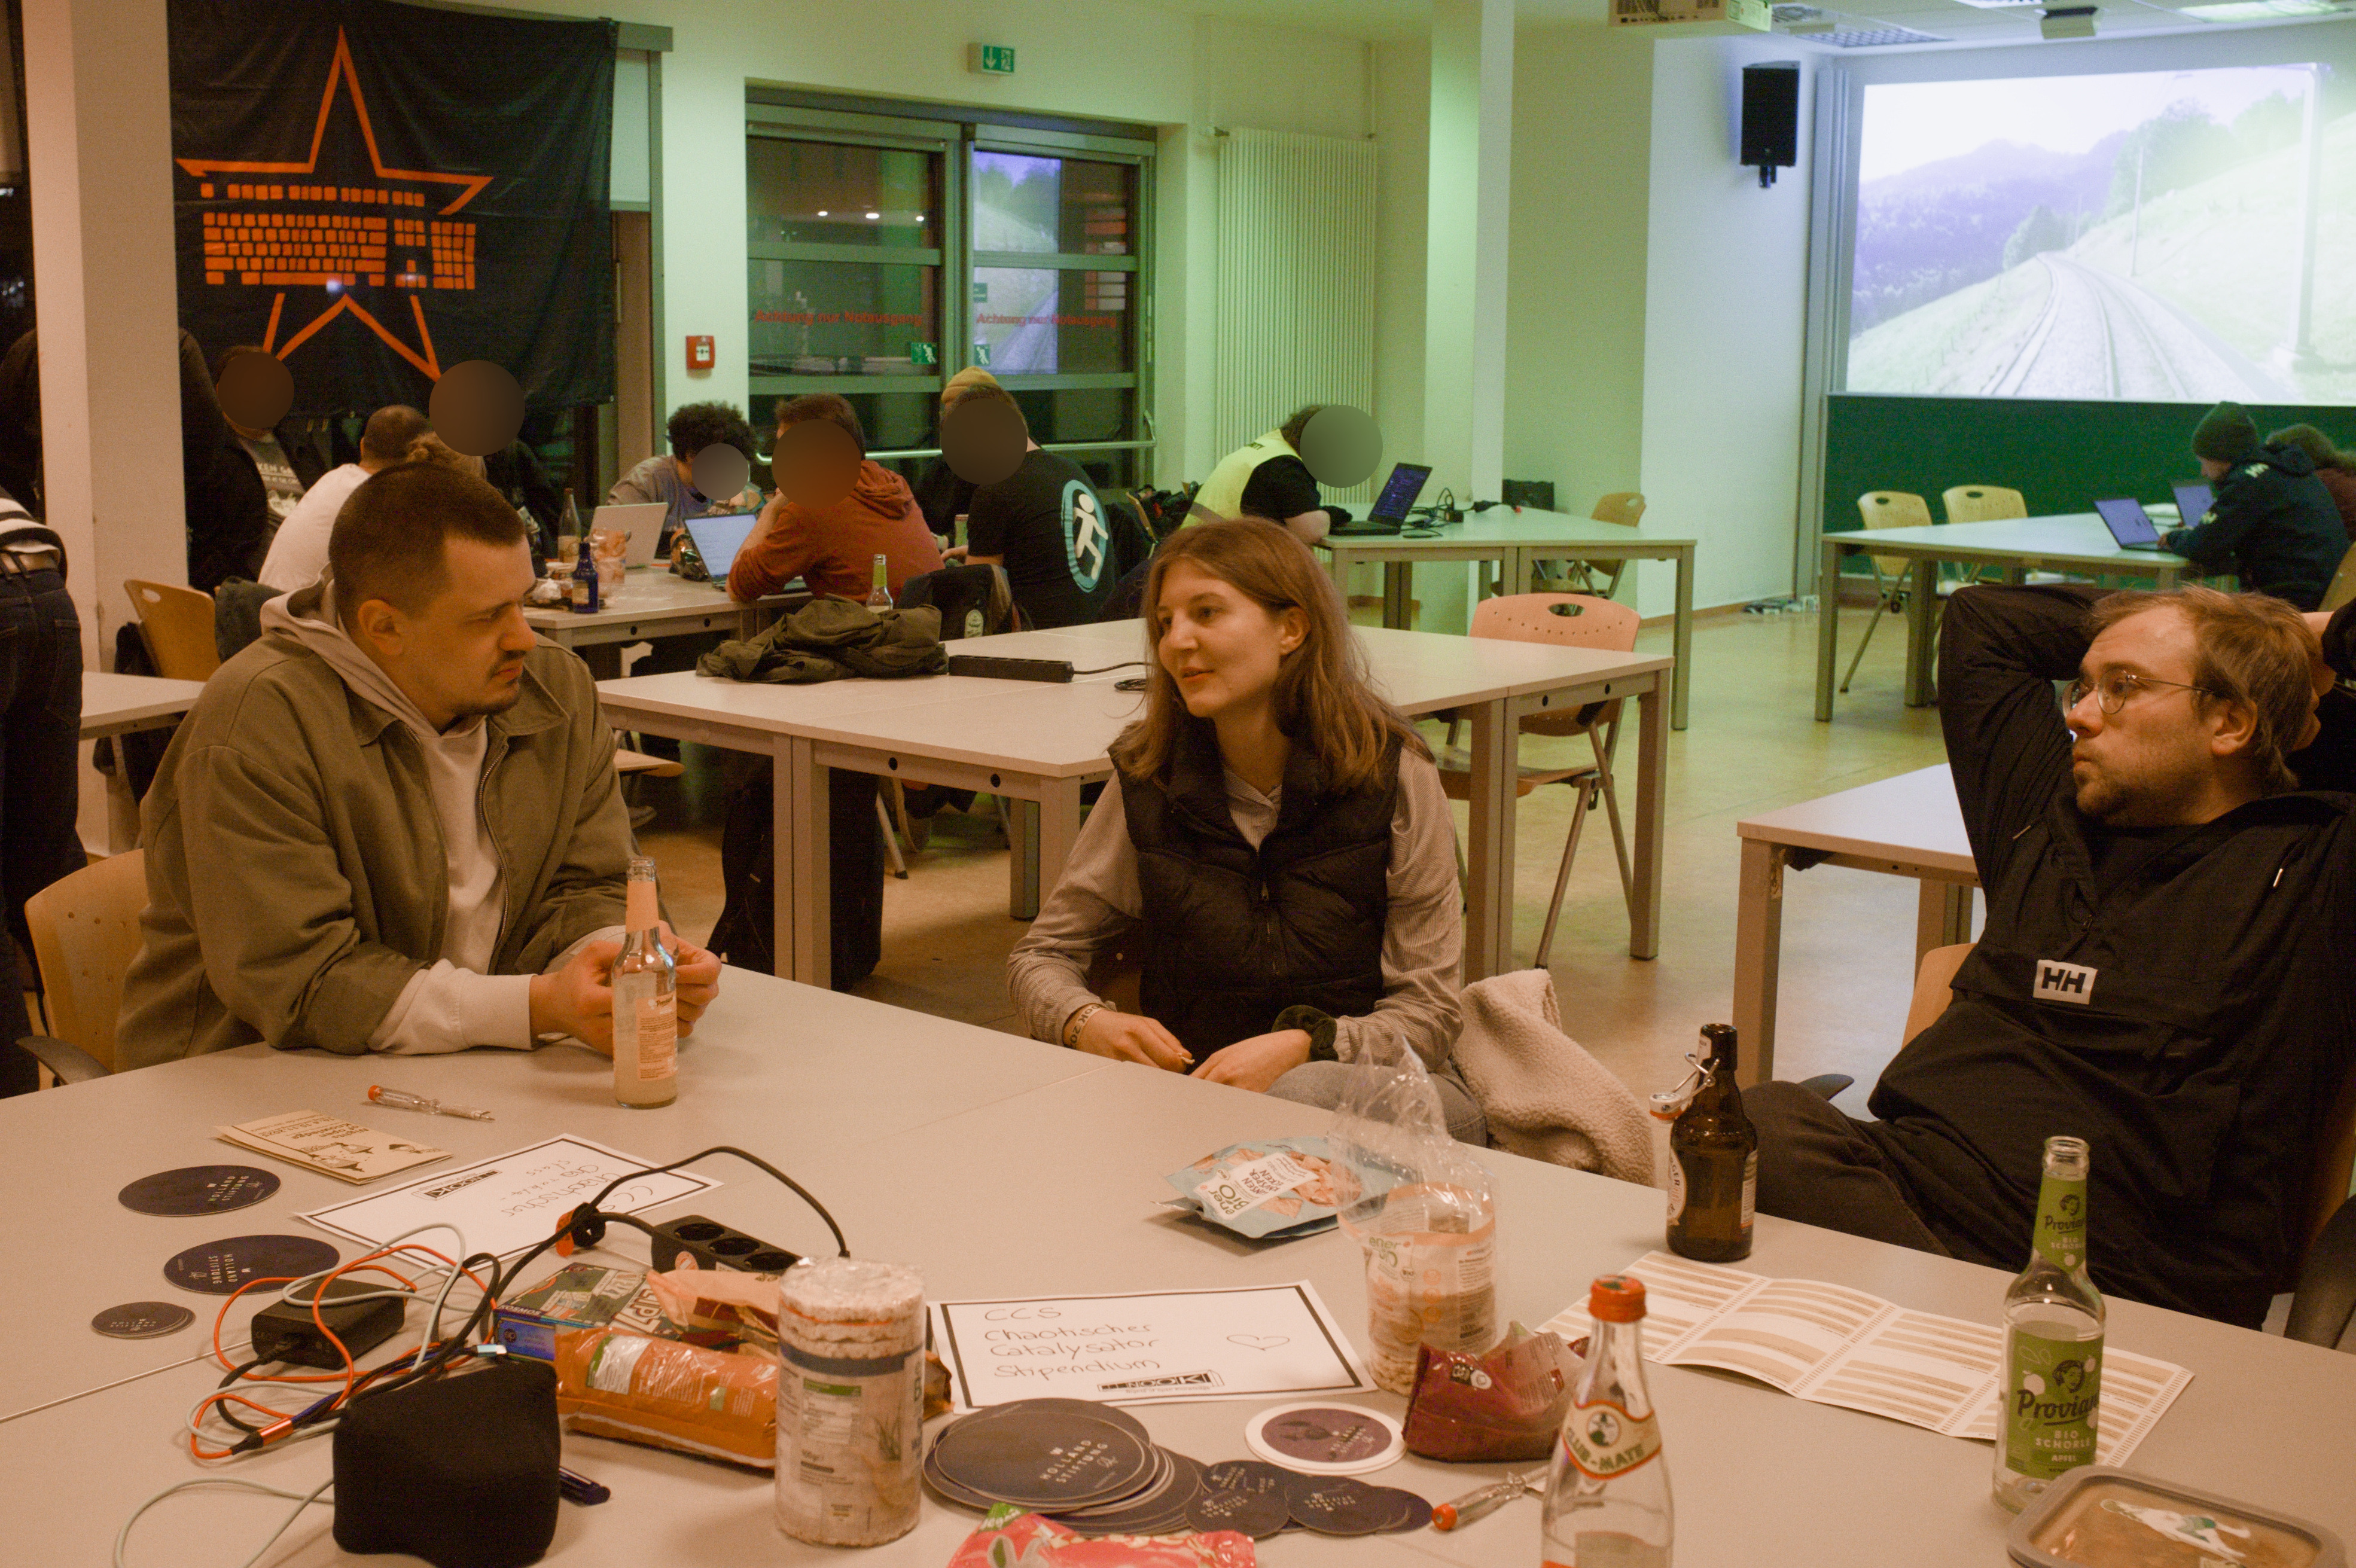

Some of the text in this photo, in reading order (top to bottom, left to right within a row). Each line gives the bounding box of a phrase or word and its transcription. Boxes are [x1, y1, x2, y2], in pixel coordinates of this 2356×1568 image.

[755, 310, 922, 328] Achtung nur Notausgang
[977, 313, 1117, 328] Achtung nur Notausgang
[2041, 967, 2087, 994] HH
[291, 1122, 352, 1139] Knowledge
[331, 1127, 370, 1139] Nights
[1208, 1190, 1236, 1215] ener
[1369, 1236, 1401, 1250] ener
[498, 1304, 543, 1317] KOSMOS
[985, 1307, 1062, 1321] CCS
[985, 1324, 1151, 1341] Chaotischer
[990, 1338, 1159, 1360] Catalysator
[994, 1359, 1161, 1381] Stipendium
[2016, 1388, 2099, 1418] Provian
[2054, 1430, 2079, 1439] BIO
[1039, 1439, 1092, 1480] HOLLAND
[1055, 1443, 1108, 1484] STIFTUNG
[980, 1508, 1021, 1531] vegan
